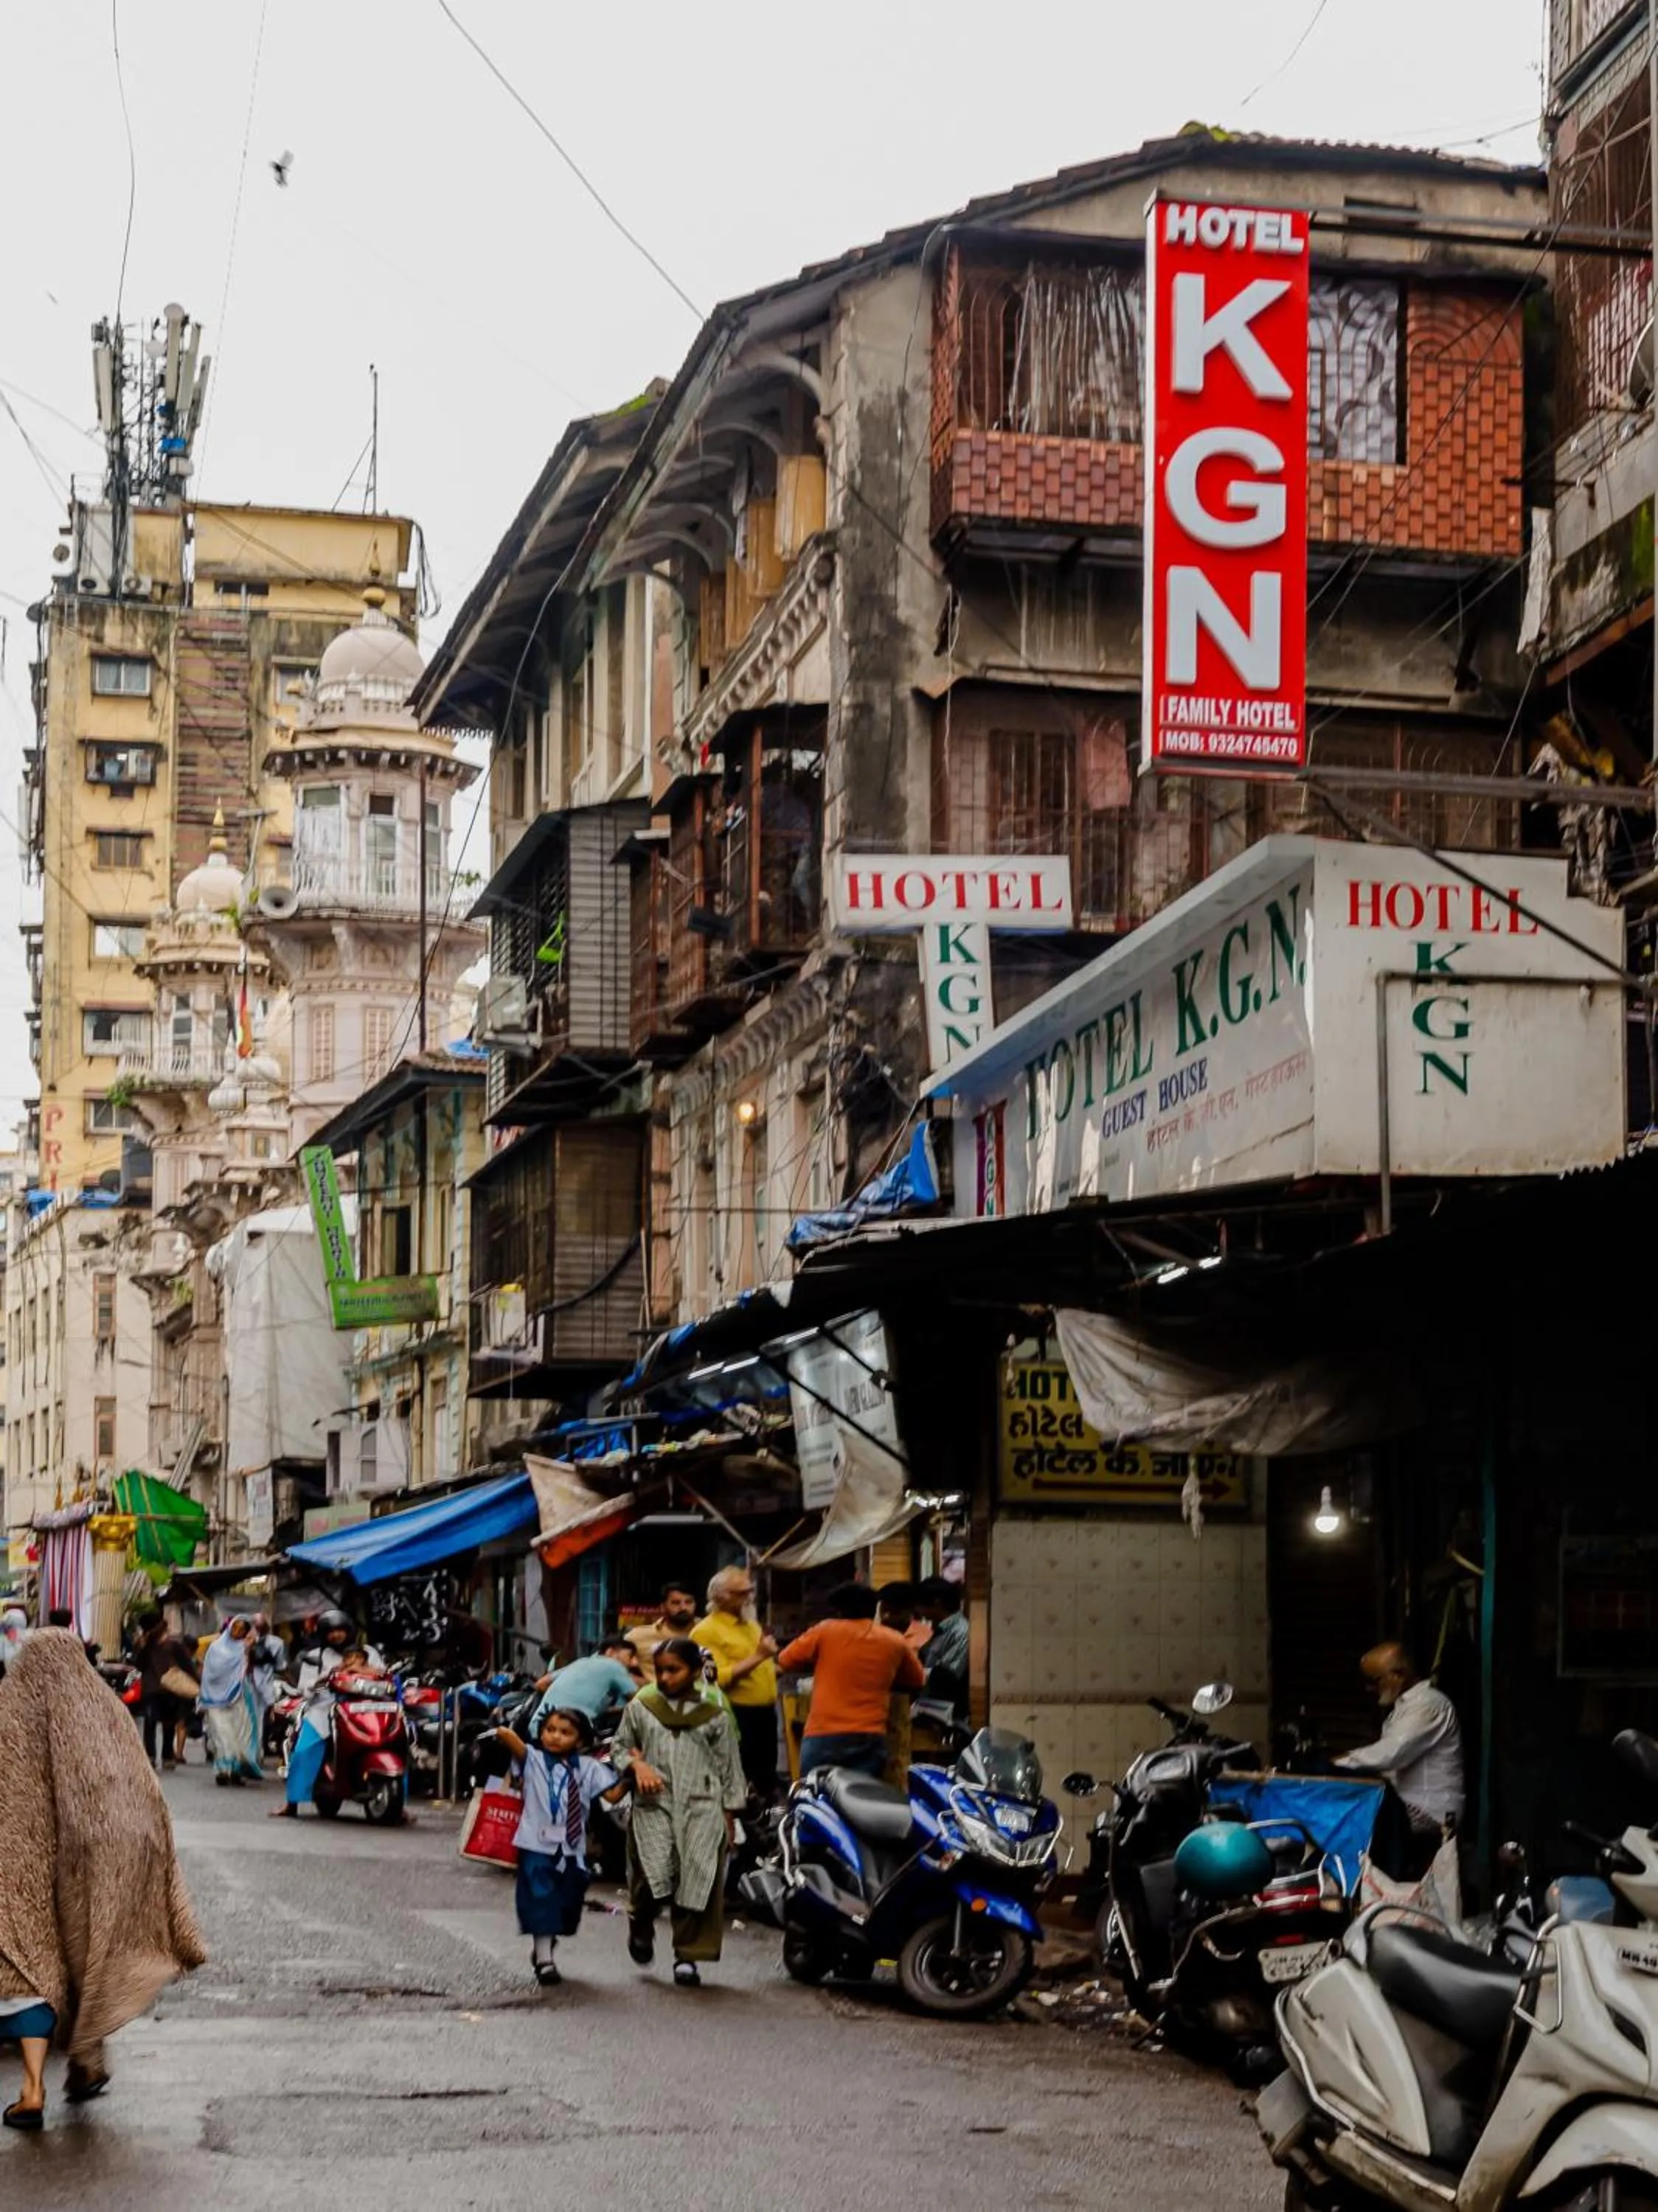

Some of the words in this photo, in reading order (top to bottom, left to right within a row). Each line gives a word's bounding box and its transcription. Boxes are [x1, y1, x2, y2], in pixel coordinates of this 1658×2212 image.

[1163, 202, 1305, 254] HOTEL
[1168, 695, 1232, 726] FAMILY
[1236, 700, 1296, 730] HOTEL
[845, 870, 1064, 911] HOTEL
[1345, 879, 1540, 936] HOTEL
[1102, 1088, 1148, 1139] GUEST
[1158, 1056, 1208, 1113] HOUSE
[1006, 1369, 1079, 1401] HOT
